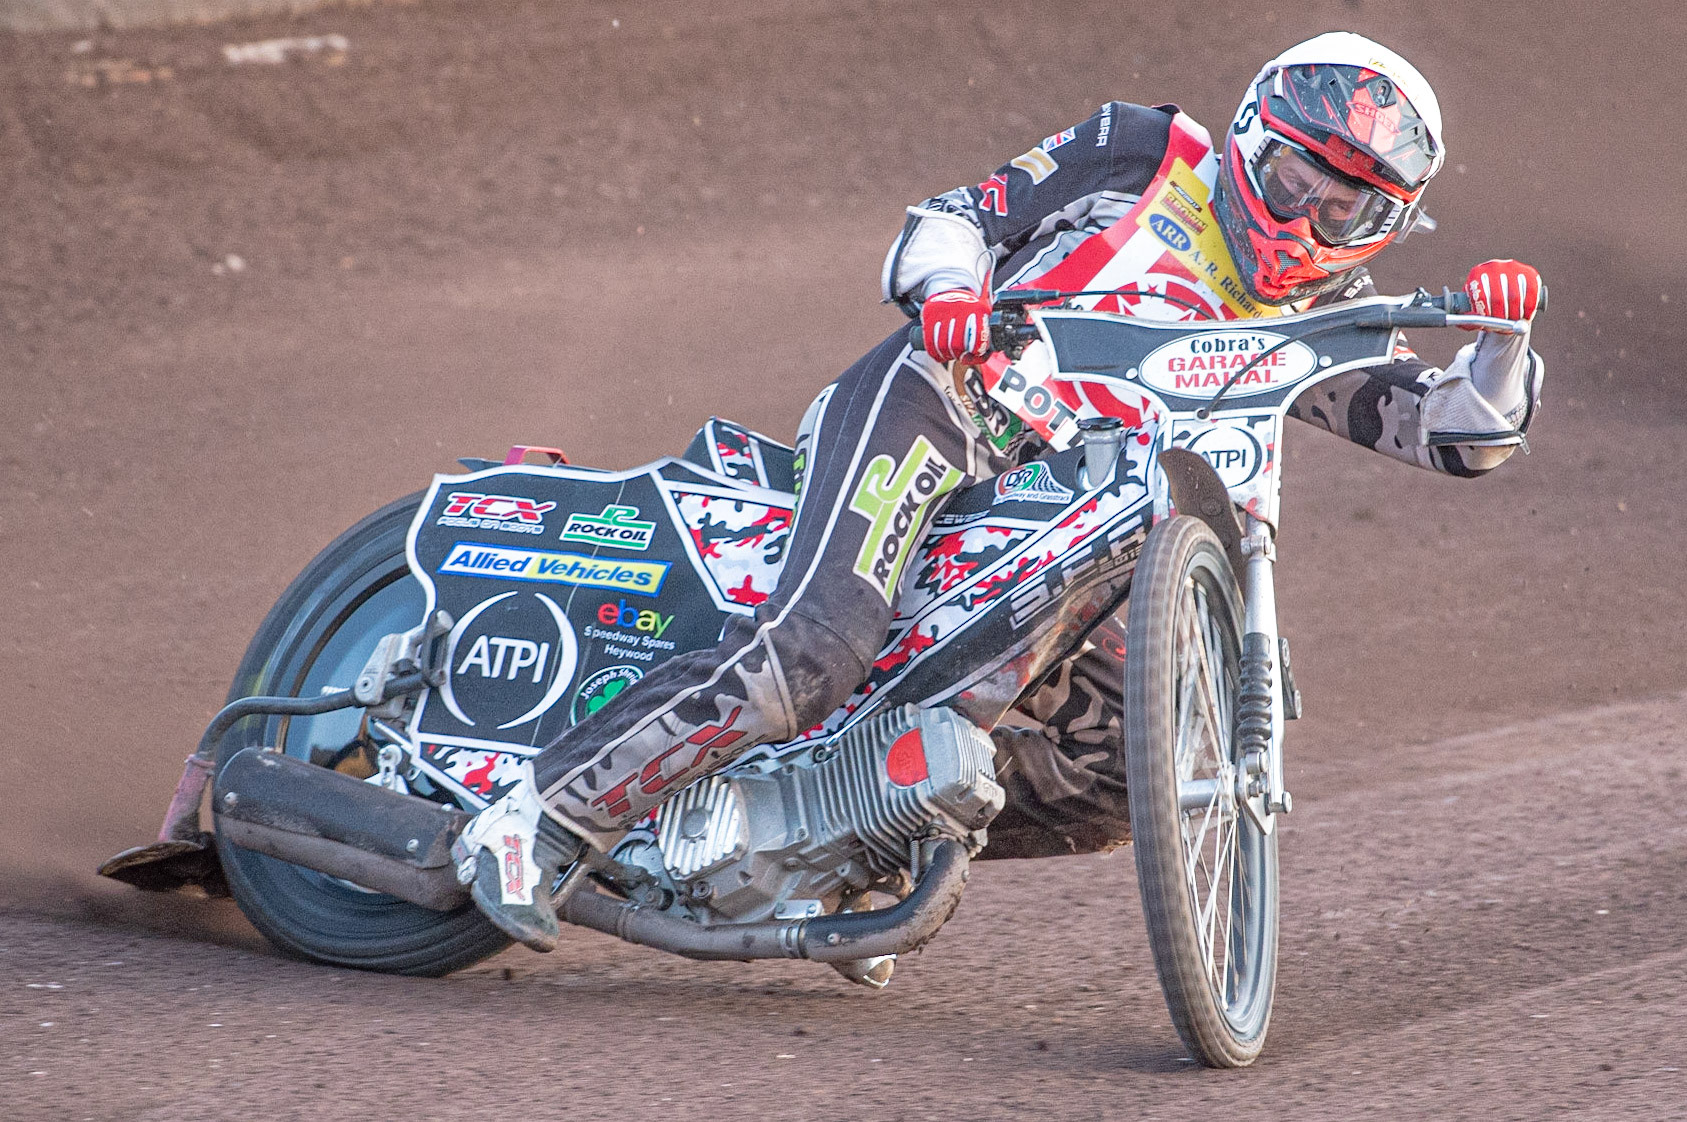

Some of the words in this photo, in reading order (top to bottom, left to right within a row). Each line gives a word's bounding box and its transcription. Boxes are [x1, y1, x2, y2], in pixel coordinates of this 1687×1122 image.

[1354, 102, 1396, 133] SHOEI
[1151, 219, 1188, 249] ARR
[1205, 262, 1218, 280] R.
[1190, 336, 1265, 353] Cobra's
[1168, 352, 1286, 372] GARAGE
[1175, 370, 1278, 389] MAHAL
[998, 367, 1081, 447] POT
[444, 492, 556, 523] TCX
[873, 490, 921, 587] ROCK
[915, 456, 947, 496] OIL
[567, 523, 620, 538] ROCK
[620, 530, 648, 541] OIL
[450, 550, 532, 573] Allied
[536, 559, 653, 587] Vehicles
[597, 599, 675, 639] ebay
[584, 625, 640, 646] Speedway
[641, 635, 675, 650] Spares
[604, 643, 654, 661] Heywood
[456, 635, 550, 684] ATPI
[580, 669, 617, 700] Joseph
[592, 705, 748, 817] TCX
[503, 834, 526, 901] TCX
